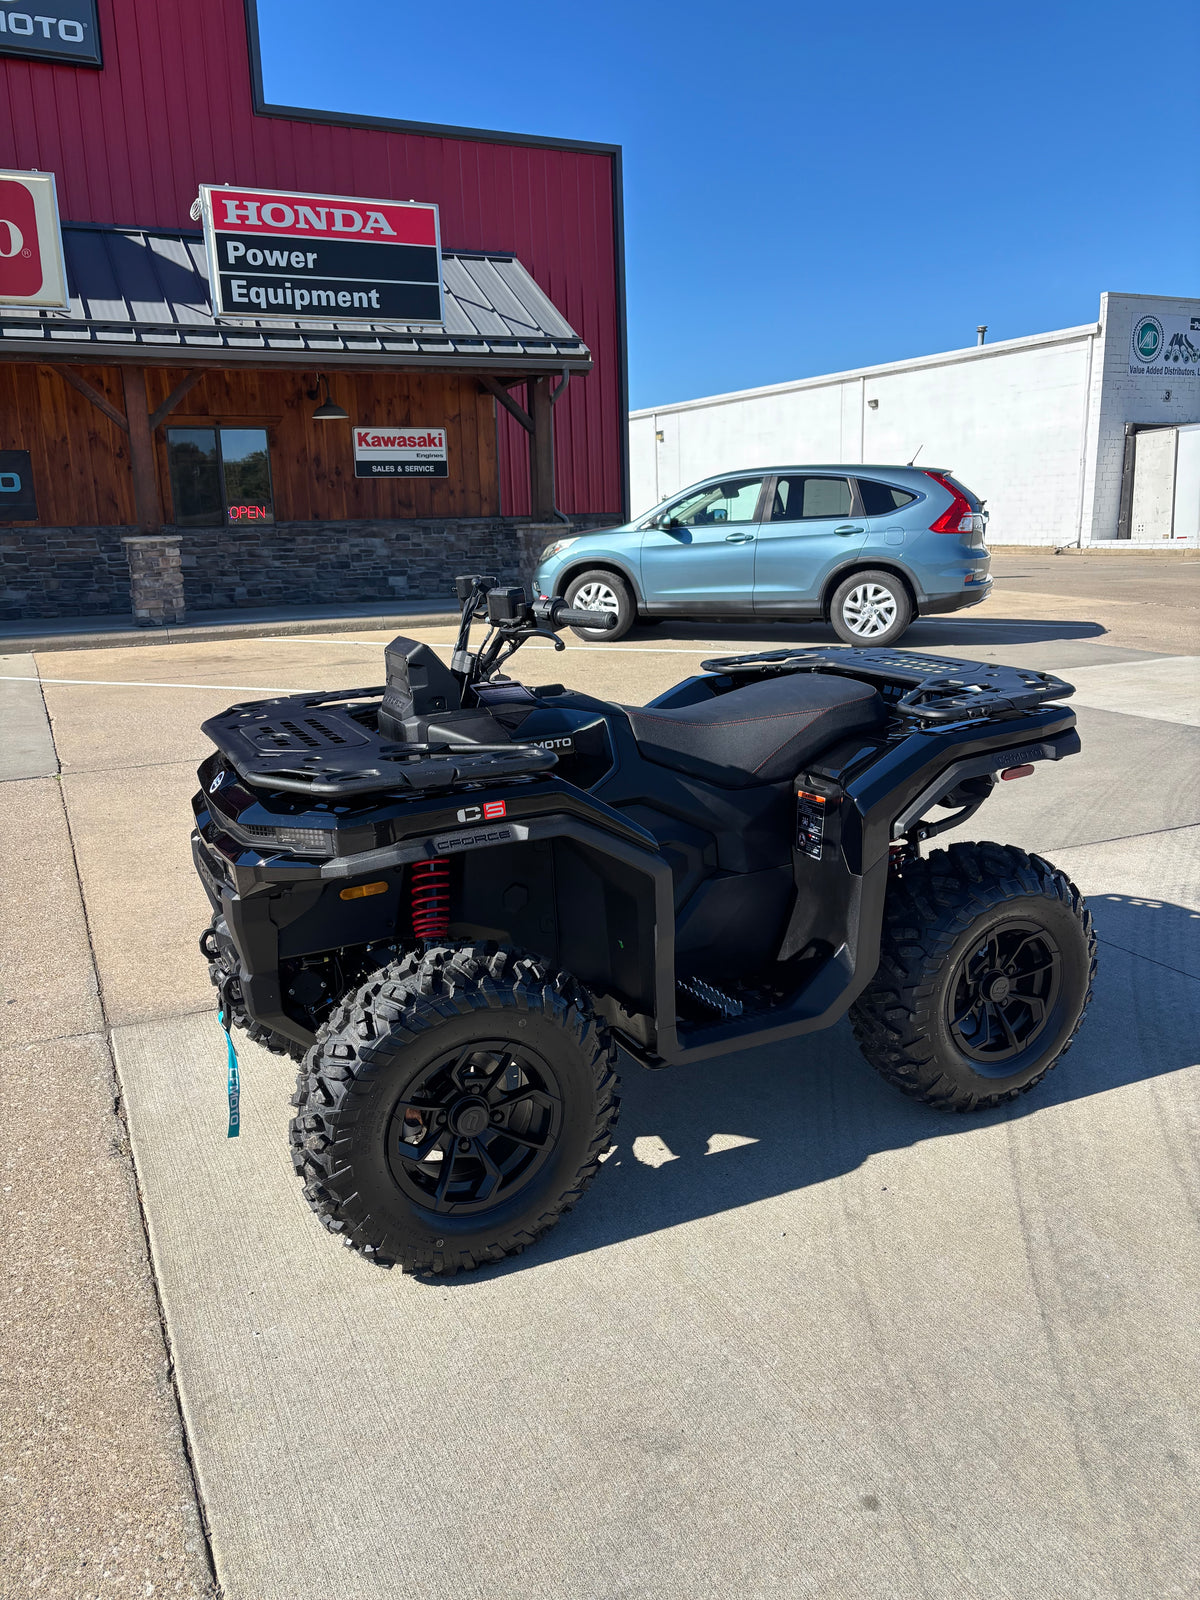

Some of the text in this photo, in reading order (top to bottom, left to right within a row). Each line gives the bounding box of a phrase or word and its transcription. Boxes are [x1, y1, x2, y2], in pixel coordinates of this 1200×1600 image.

[0, 11, 84, 43] OTO
[222, 200, 397, 236] HONDA
[226, 241, 318, 269] Power
[231, 279, 381, 311] Equipment
[1129, 365, 1145, 375] Value
[1146, 365, 1164, 376] Added
[1164, 391, 1170, 401] 3
[357, 432, 443, 448] Kawasaki
[371, 465, 435, 473] SALES & SERVICE
[229, 505, 266, 519] OPEN
[230, 1068, 239, 1126] CFMOTO
